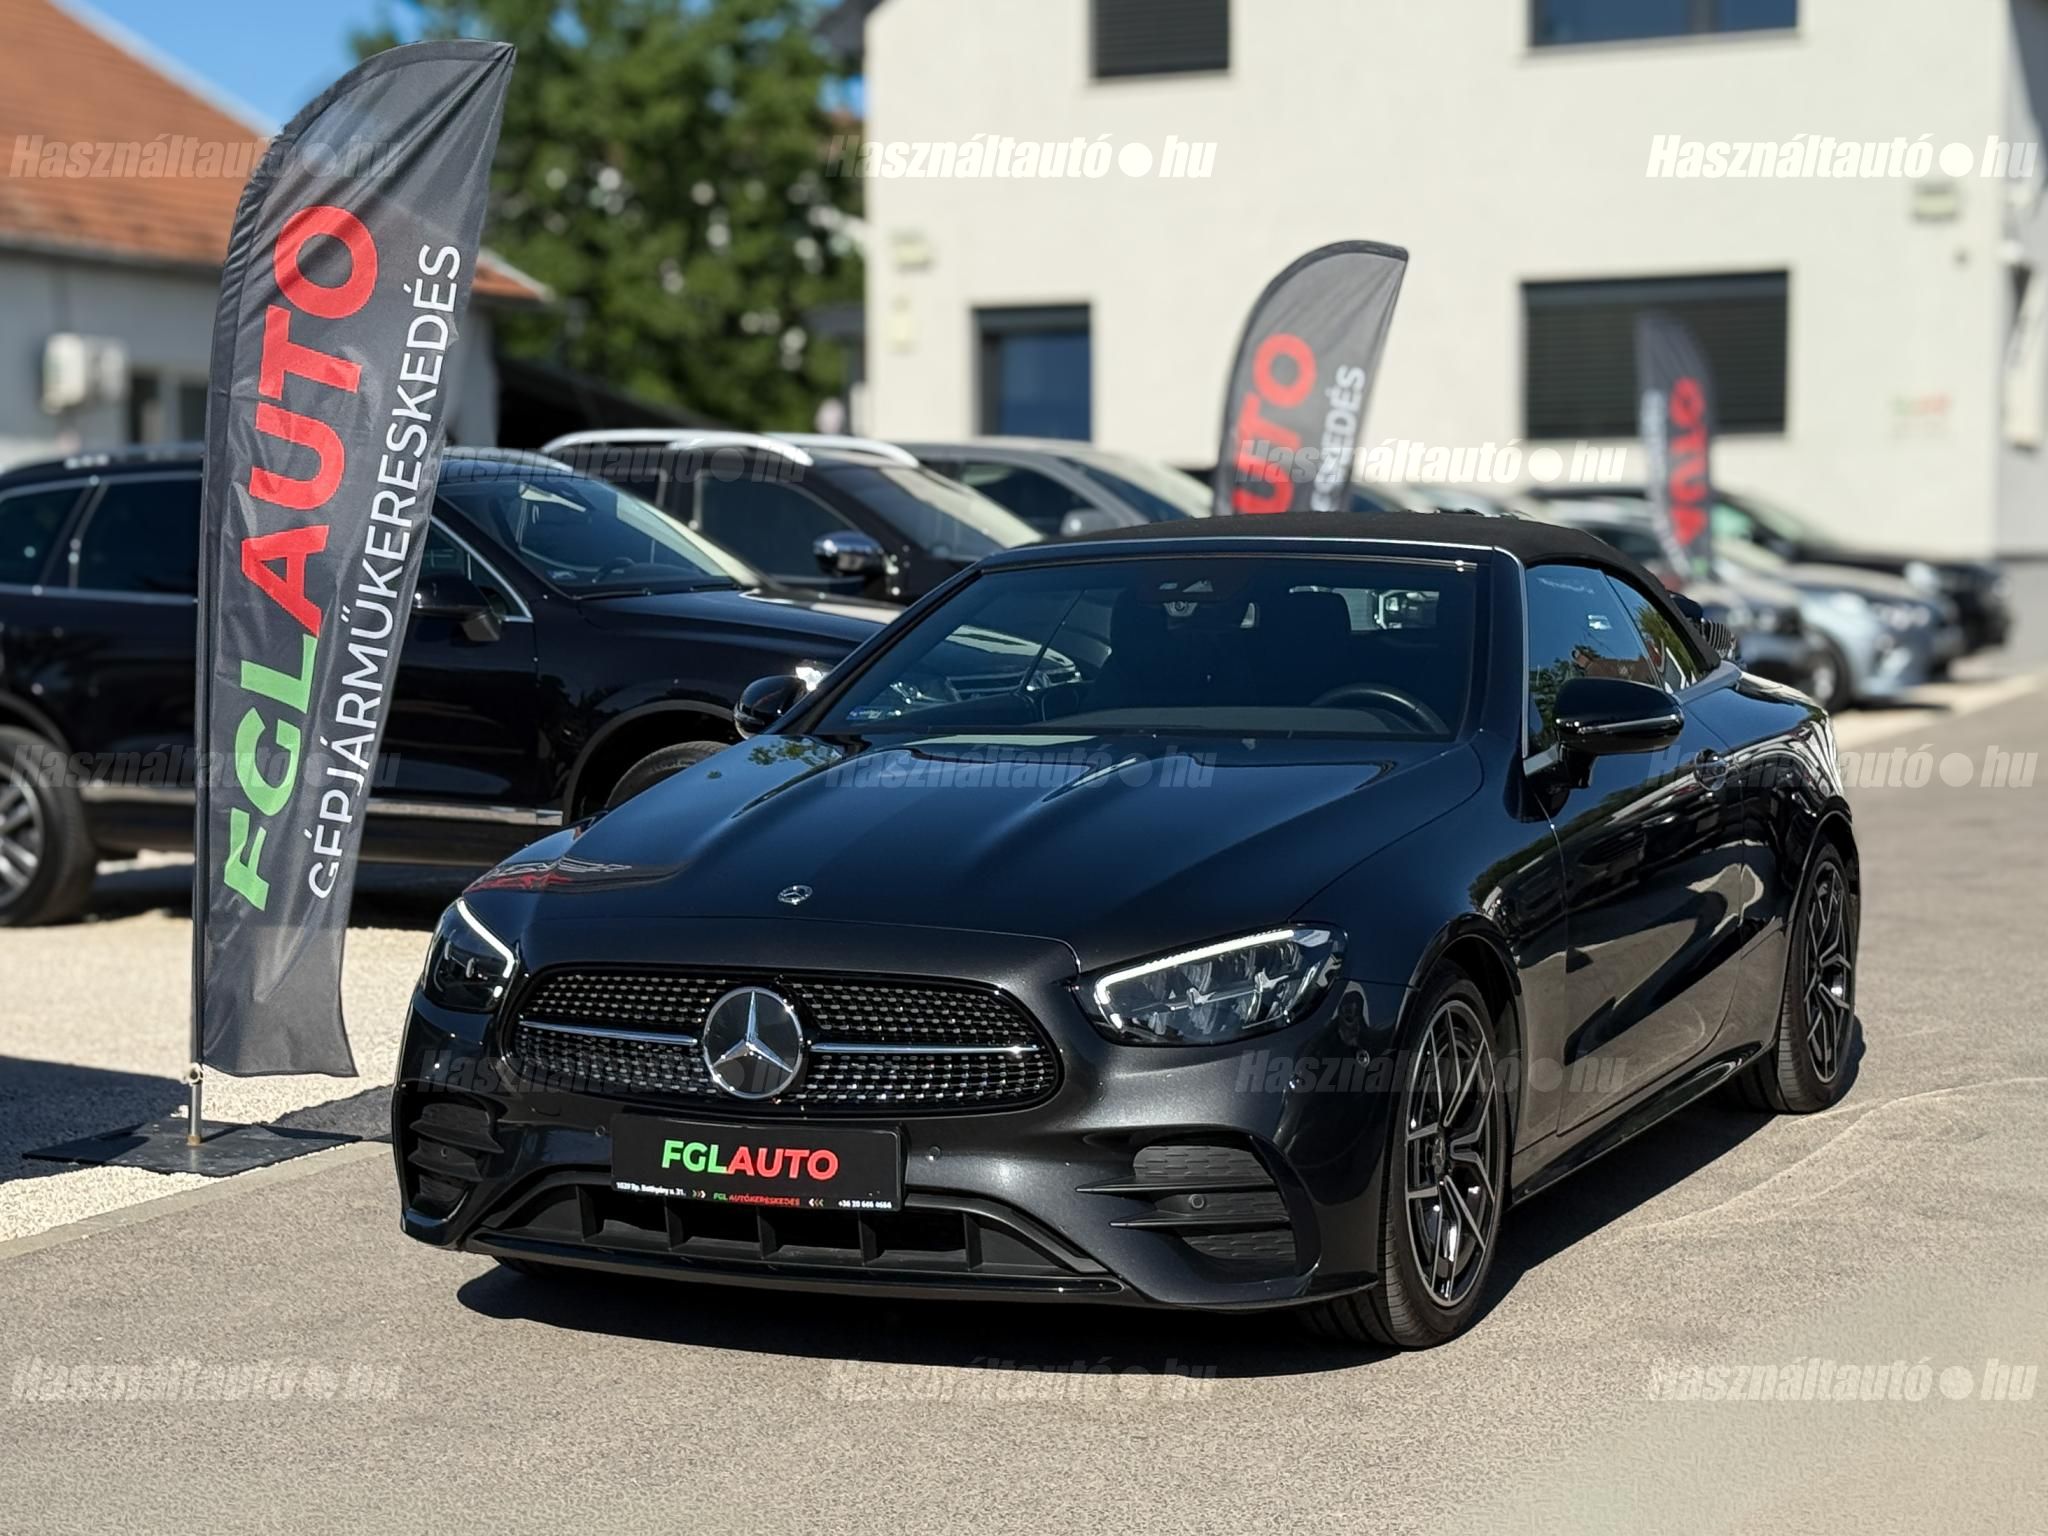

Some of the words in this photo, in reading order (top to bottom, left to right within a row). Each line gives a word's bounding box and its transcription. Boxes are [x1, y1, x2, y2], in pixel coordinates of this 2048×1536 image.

[224, 205, 379, 912] FGLAUTO
[308, 244, 462, 899] GÉPJÁRMŰKERESKEDÉS
[661, 1139, 839, 1180] FGLAUTO
